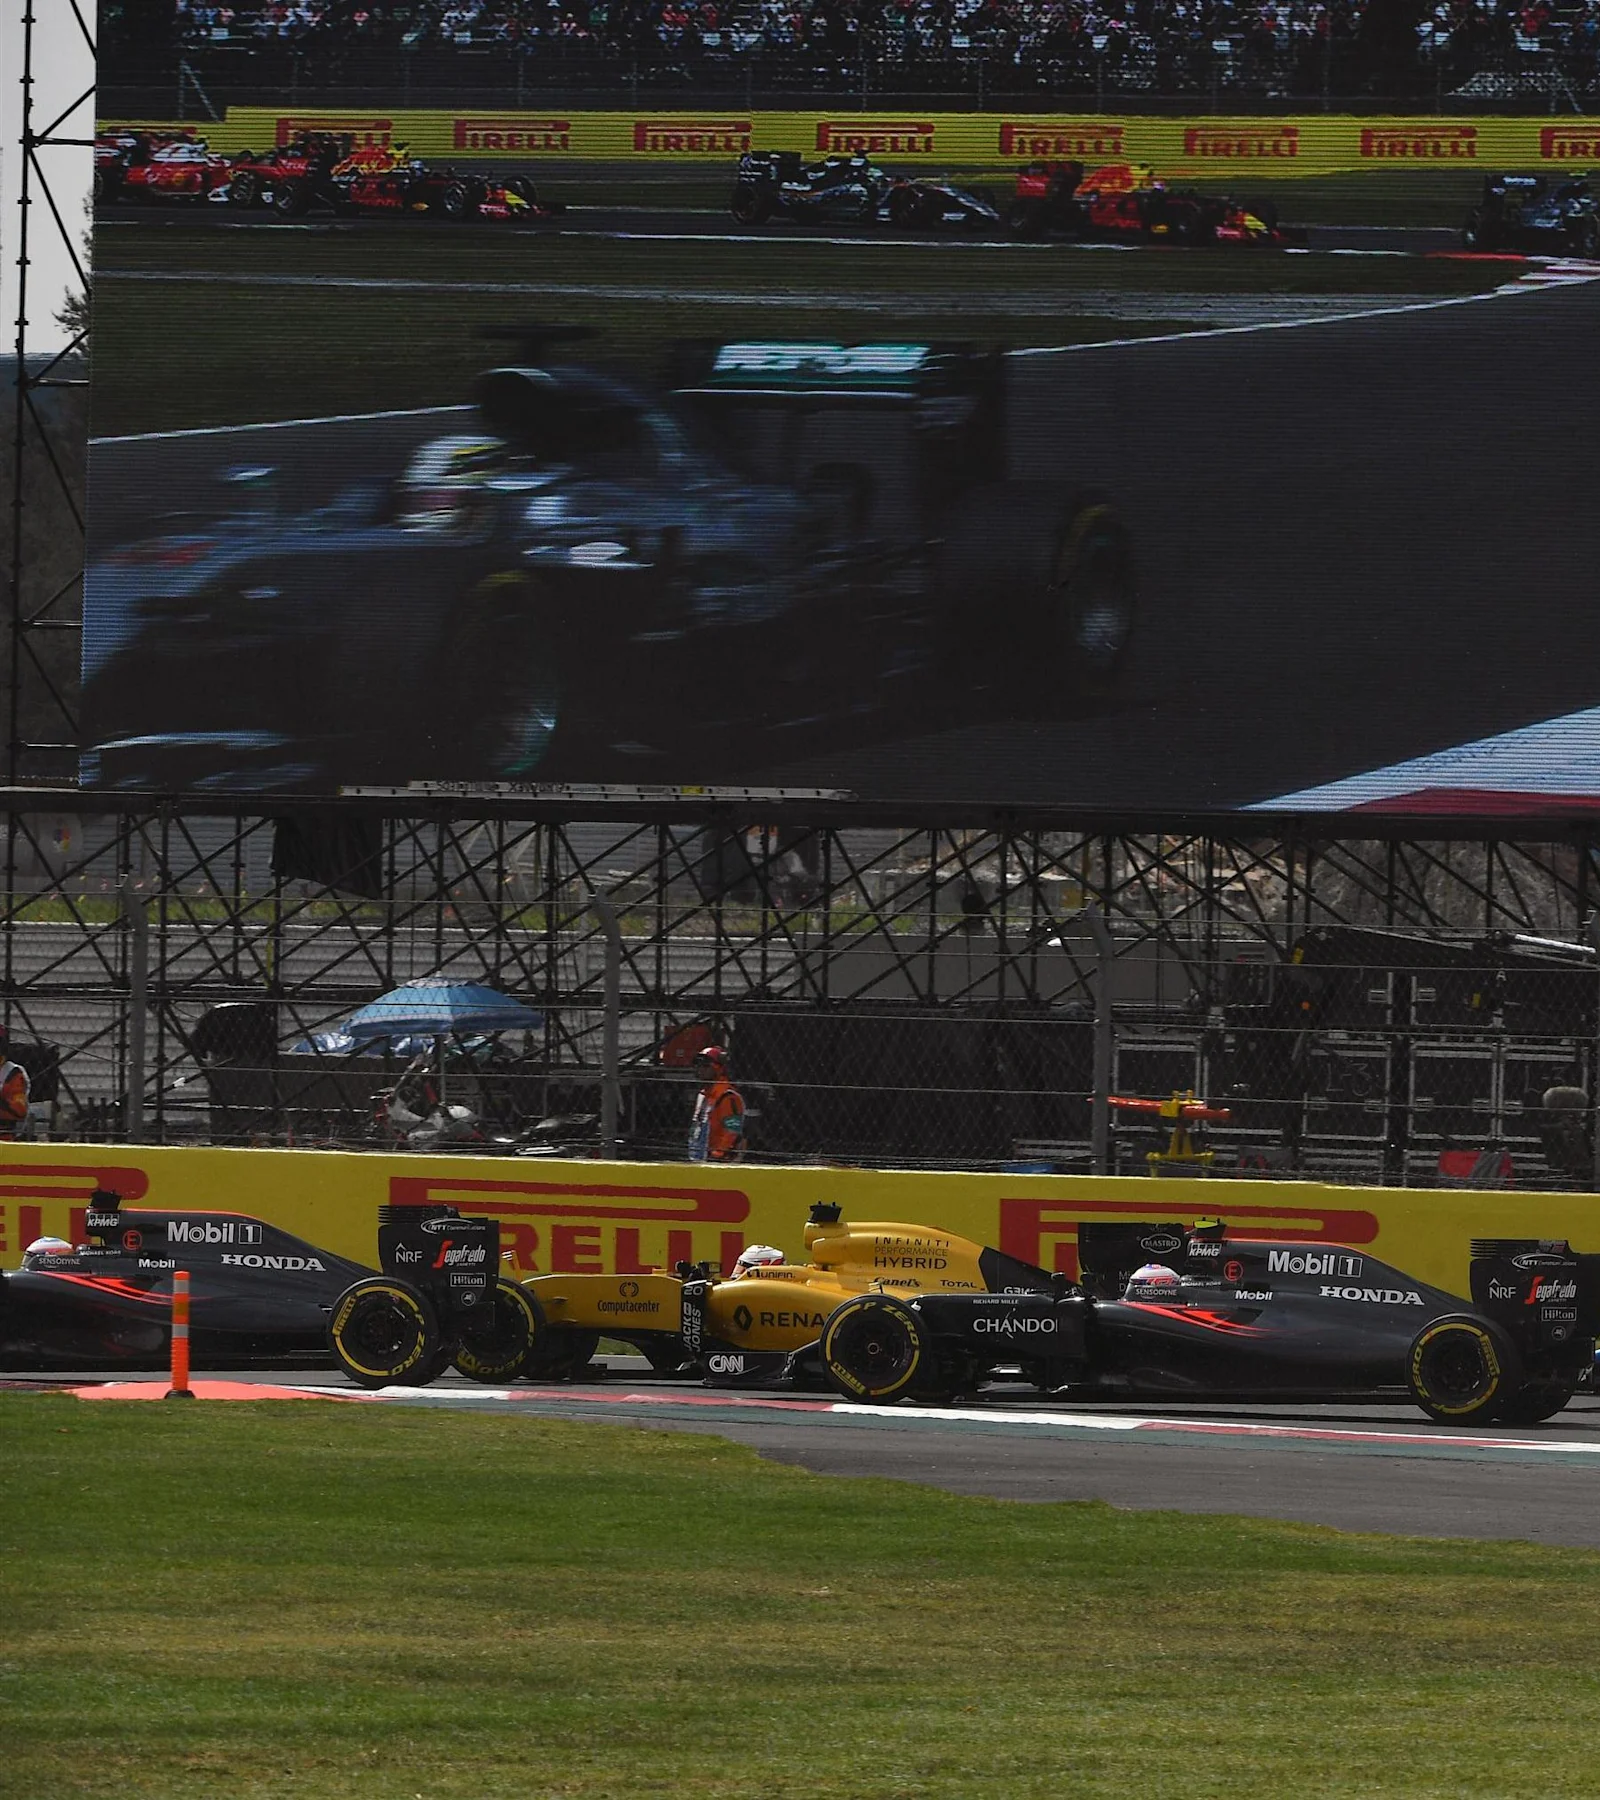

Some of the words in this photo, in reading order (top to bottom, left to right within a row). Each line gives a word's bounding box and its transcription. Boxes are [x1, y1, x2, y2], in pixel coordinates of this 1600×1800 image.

[454, 119, 570, 151] PIRELLI
[633, 121, 752, 151] PIRELLI
[815, 122, 935, 152] PIRELLI
[87, 1217, 119, 1227] KPMG
[168, 1221, 234, 1244] Mobil
[874, 1236, 950, 1248] INFINITI
[395, 1250, 424, 1264] NRF
[432, 1240, 486, 1269] Segafredo
[874, 1247, 948, 1257] PERFORMANCE
[1189, 1247, 1220, 1257] KPMG
[138, 1258, 176, 1269] Mobil
[221, 1253, 327, 1272] HONDA
[874, 1257, 947, 1269] HYBRID
[1267, 1250, 1336, 1275] Mobil
[452, 1275, 484, 1285] Hilton
[874, 1276, 922, 1288] Canel's
[940, 1279, 978, 1288] TOTAL
[683, 1285, 704, 1296] 20
[1135, 1287, 1177, 1296] SENSODYNE
[1235, 1289, 1273, 1301] Mobil
[1319, 1286, 1425, 1306] HONDA
[1489, 1285, 1517, 1299] NRF
[1524, 1276, 1577, 1305] Segafredo
[597, 1299, 660, 1314] Computacenter
[1543, 1309, 1575, 1319] Hilton
[760, 1311, 830, 1328] RENA
[881, 1302, 919, 1346] ZERO
[973, 1318, 1058, 1334] CHANDO
[683, 1317, 693, 1352] JACK
[691, 1308, 702, 1352] JONES
[389, 1332, 426, 1376] ZERO
[708, 1354, 744, 1373] CNN
[1412, 1343, 1431, 1398] ZERO
